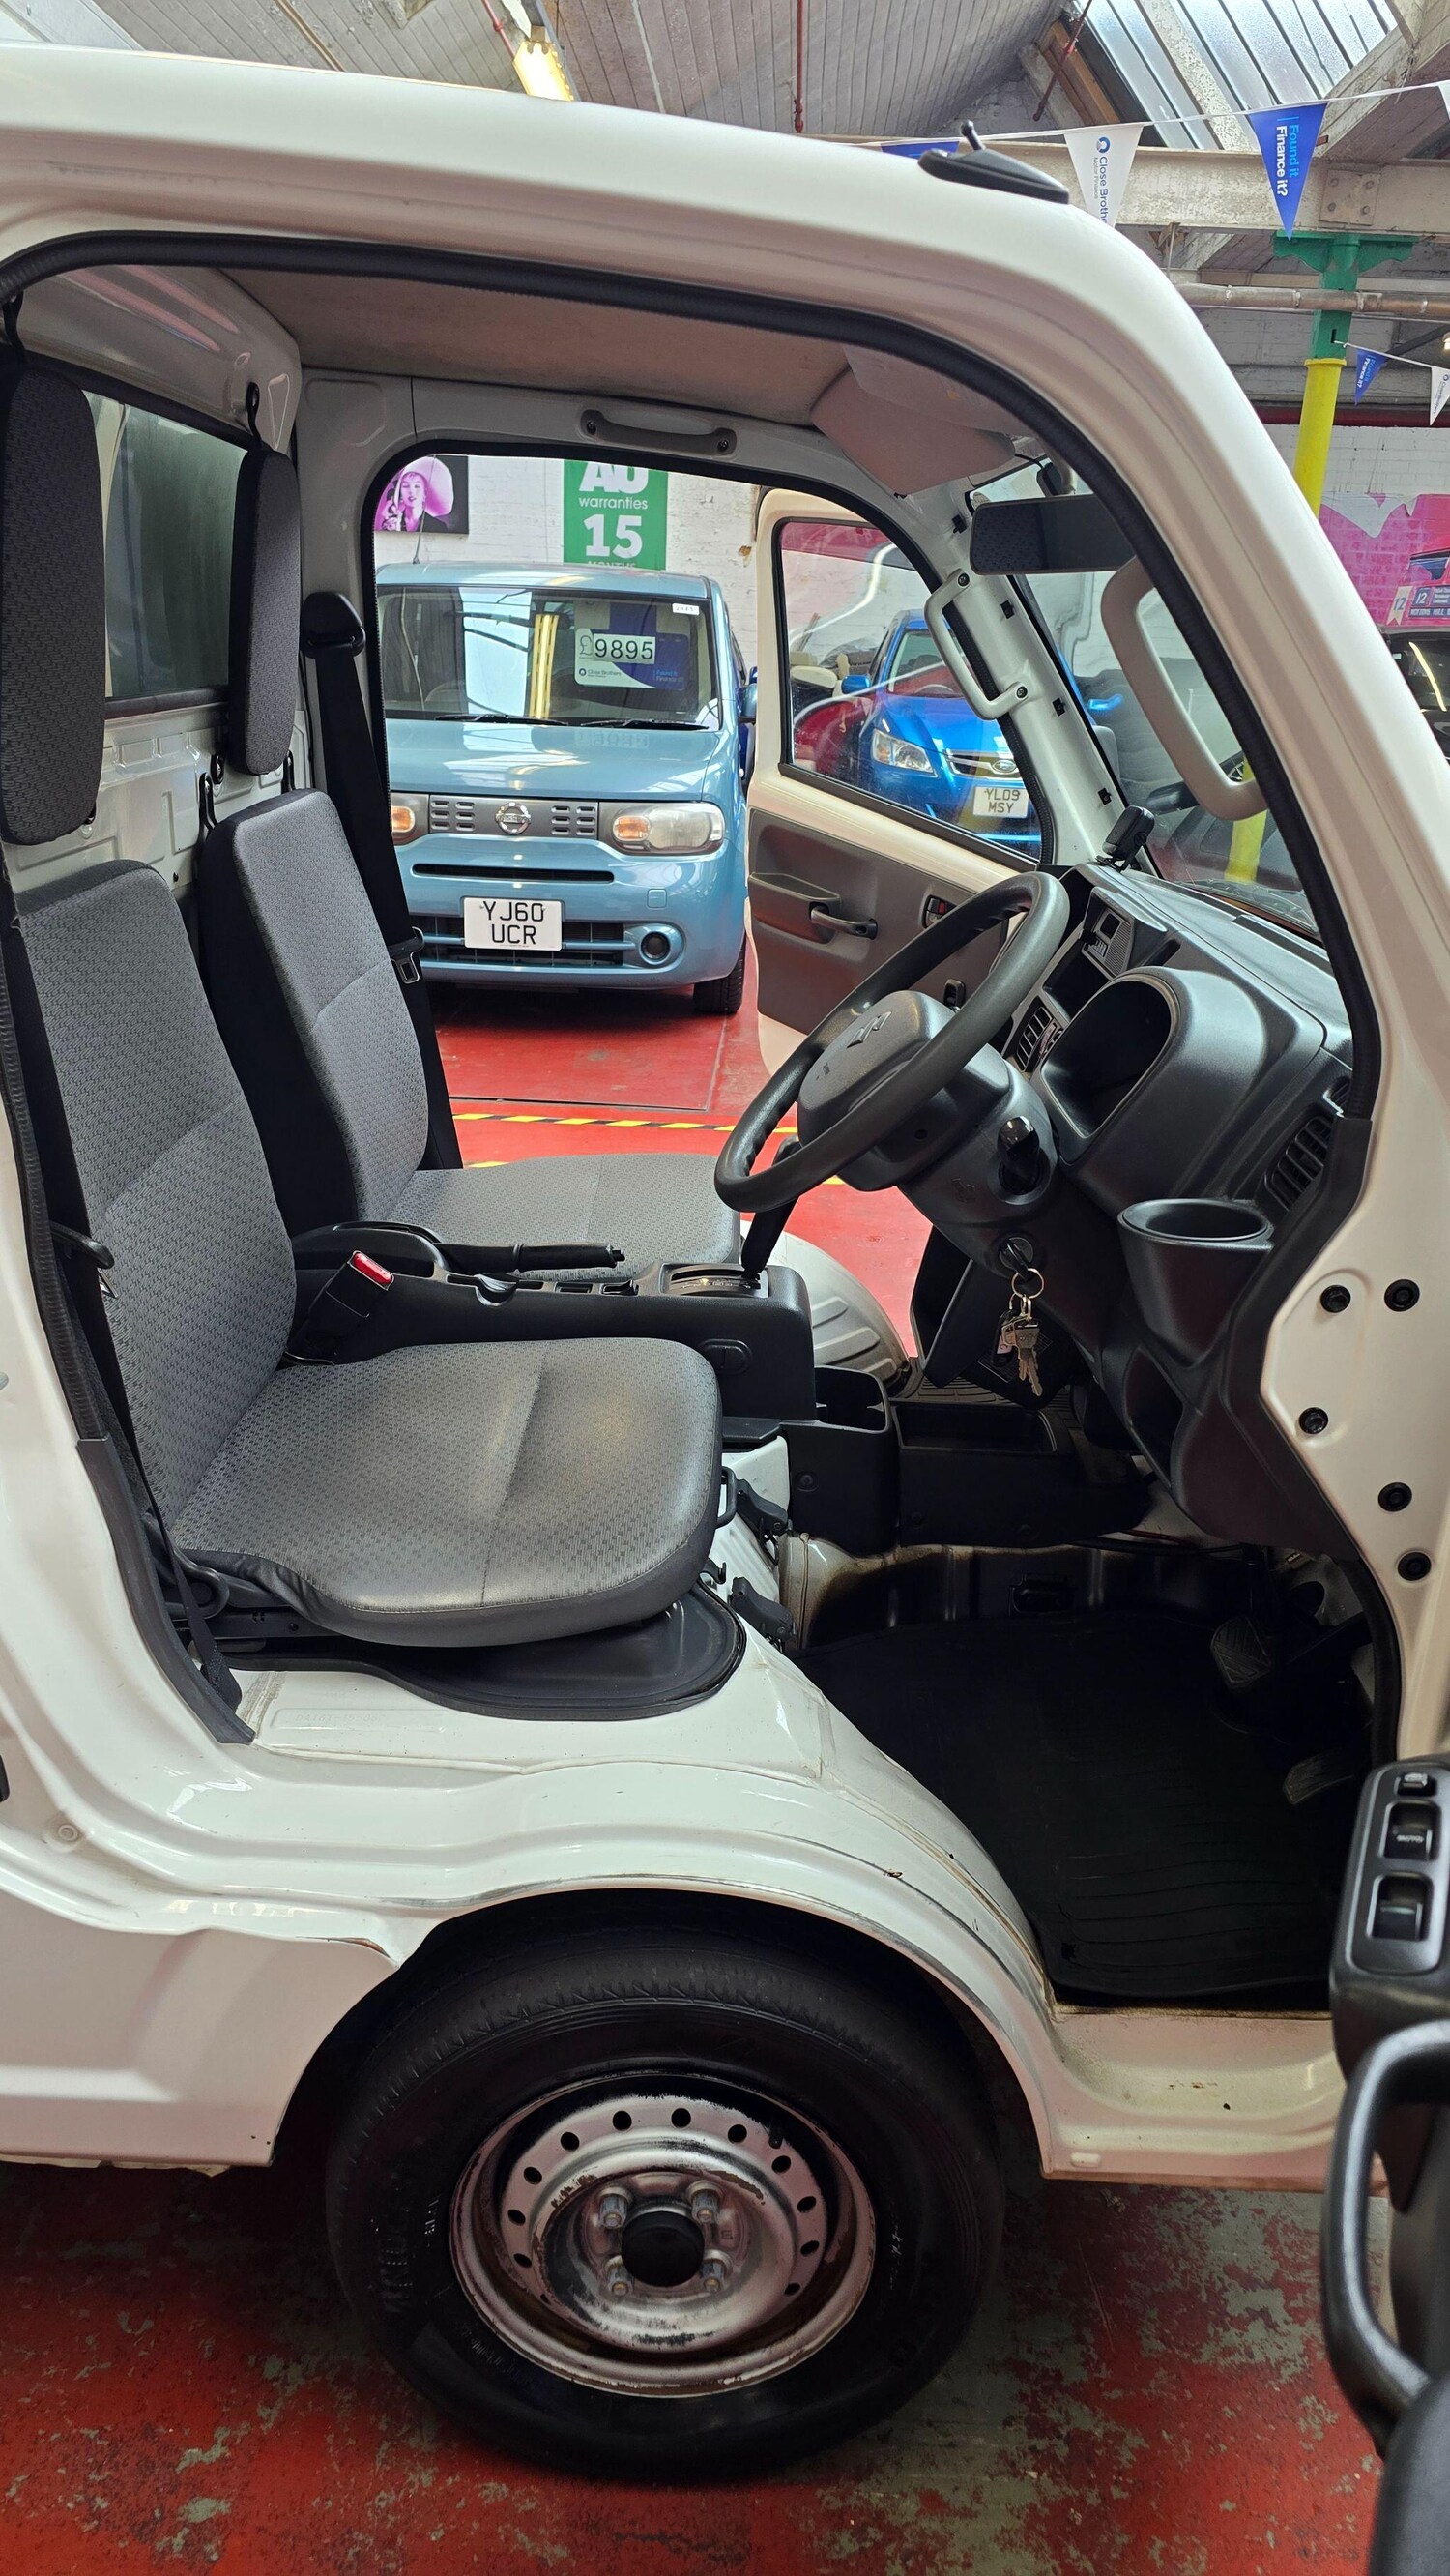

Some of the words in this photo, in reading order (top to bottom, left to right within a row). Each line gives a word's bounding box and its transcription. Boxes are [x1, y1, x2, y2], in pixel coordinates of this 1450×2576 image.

[1276, 125, 1288, 178] Finance
[1289, 124, 1299, 166] Found
[1099, 156, 1109, 187] Close
[1289, 168, 1299, 178] it
[1276, 179, 1289, 197] it?
[1360, 357, 1371, 379] Finance
[578, 496, 649, 510] warranties
[583, 514, 643, 559] 15
[1394, 597, 1406, 610] 12
[1415, 592, 1428, 604] 12
[985, 788, 1021, 801] YL09
[988, 802, 1014, 813] MSY
[483, 901, 544, 922] YJ60
[491, 924, 536, 945] UCR
